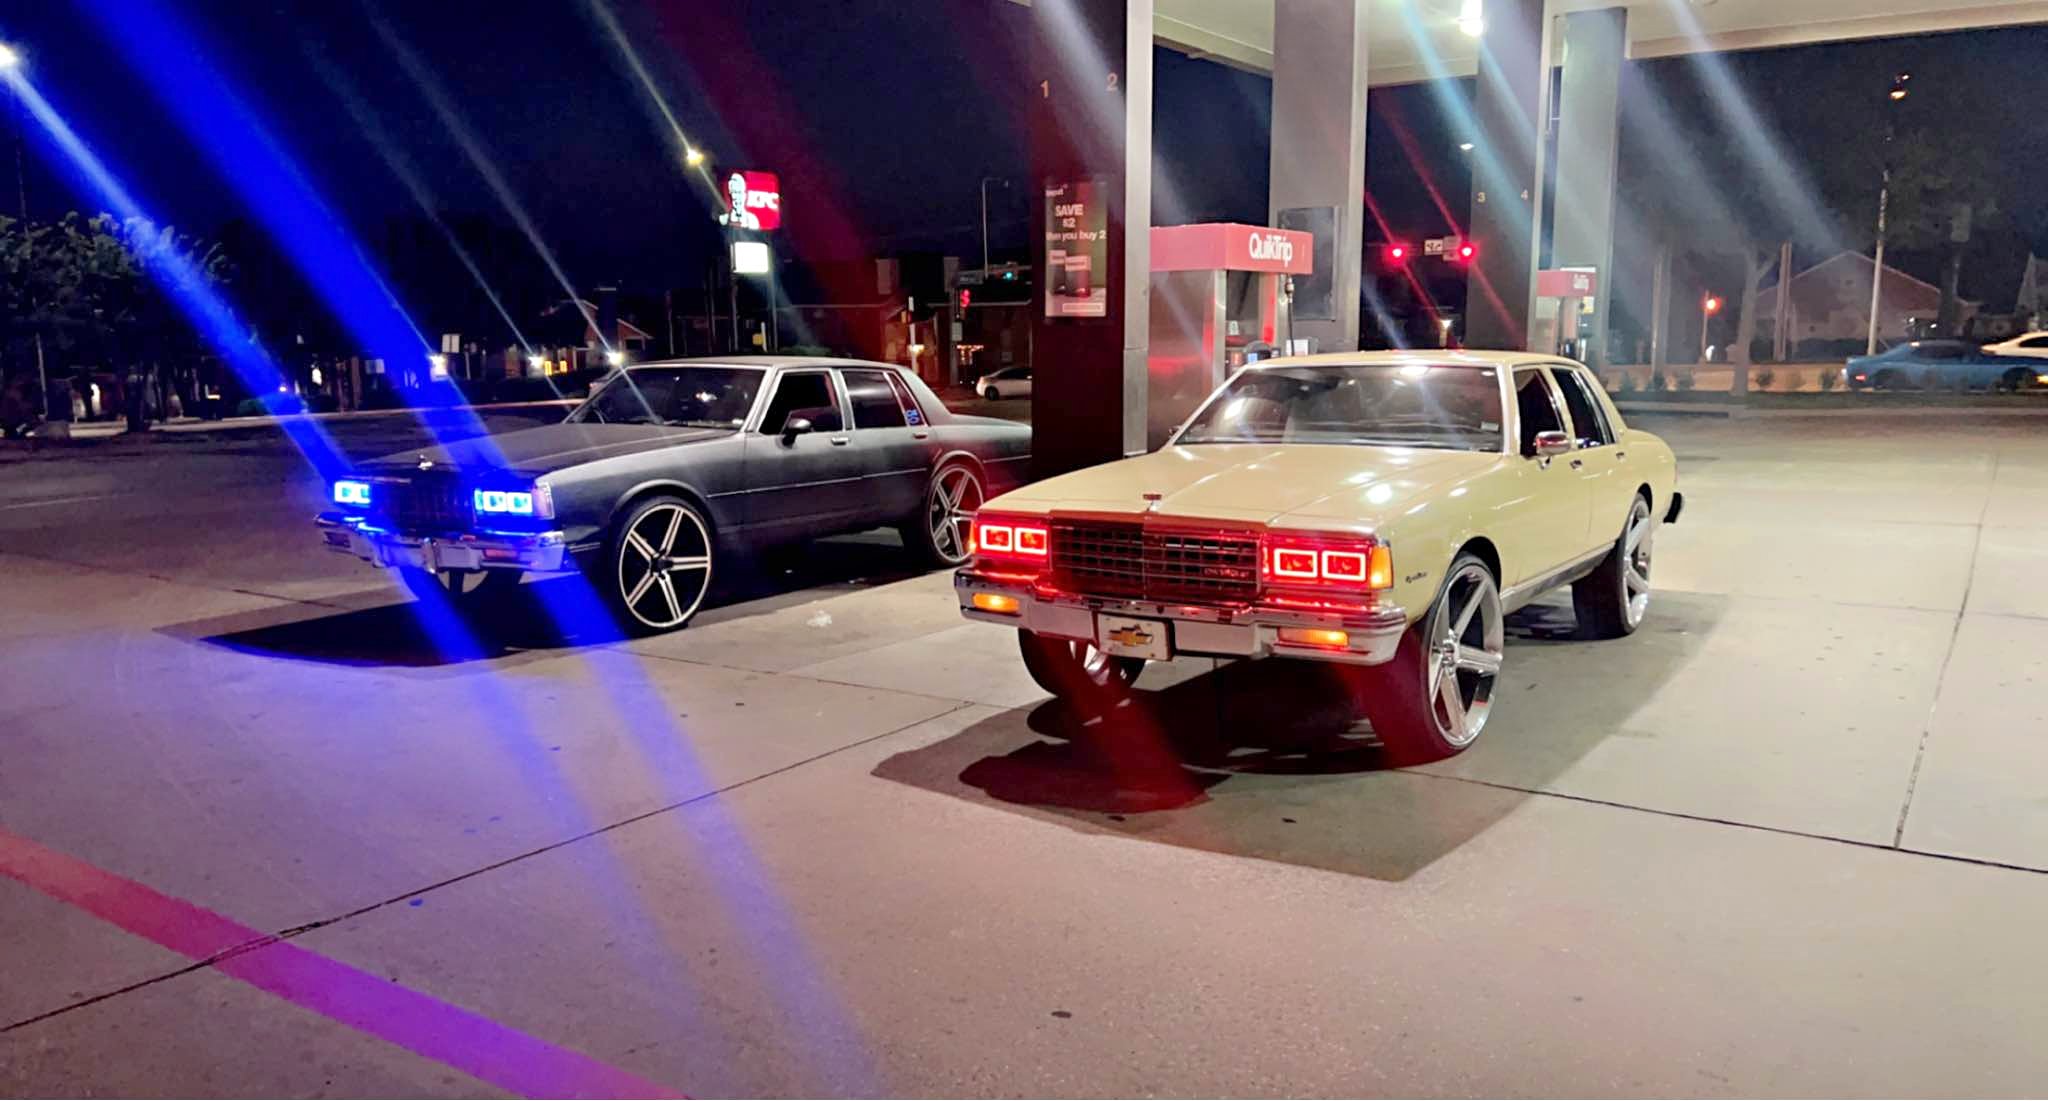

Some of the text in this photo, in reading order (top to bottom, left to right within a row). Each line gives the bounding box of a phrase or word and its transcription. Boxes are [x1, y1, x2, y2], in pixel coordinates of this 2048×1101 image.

[1040, 79, 1049, 98] 1
[1106, 72, 1118, 92] 2
[1477, 191, 1486, 202] 3
[1520, 189, 1529, 200] 4
[1055, 203, 1084, 217] SAVE
[1062, 232, 1078, 242] you
[1079, 230, 1098, 242] buy
[1098, 230, 1107, 240] 2
[1249, 232, 1293, 268] QuikTrip
